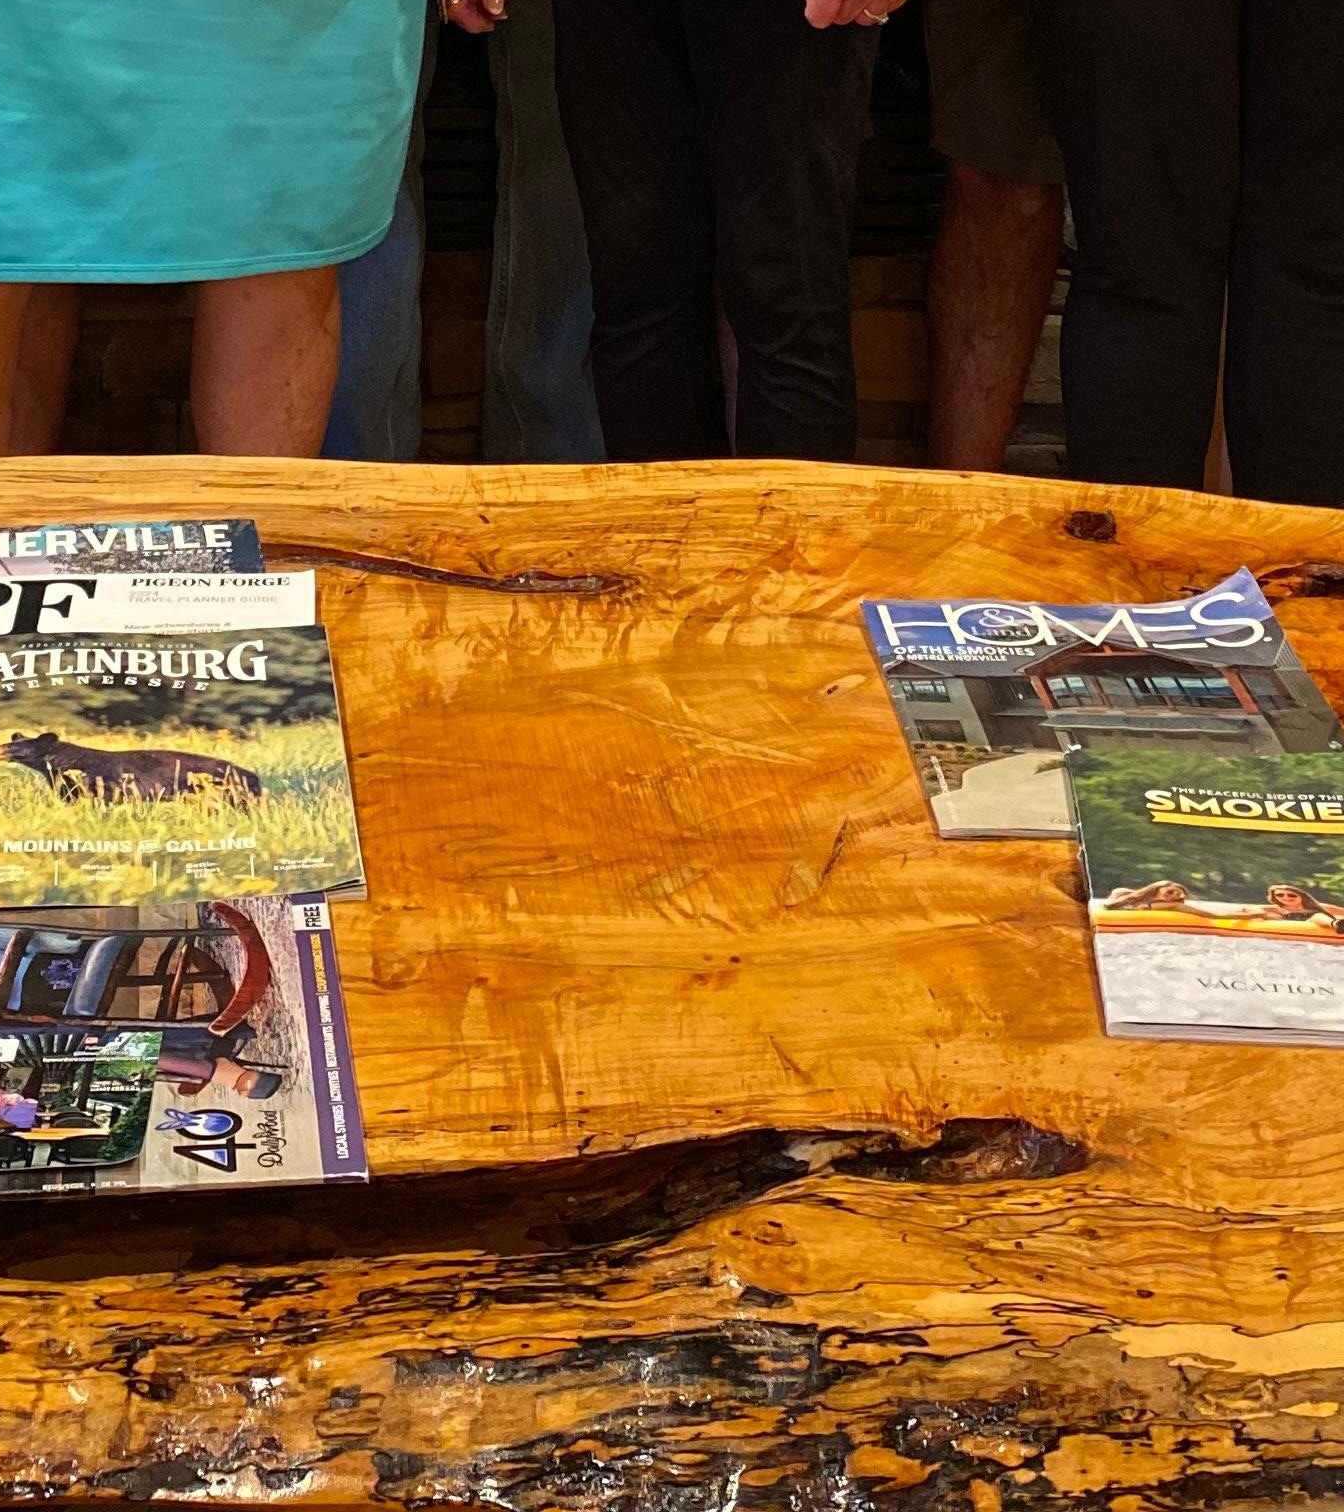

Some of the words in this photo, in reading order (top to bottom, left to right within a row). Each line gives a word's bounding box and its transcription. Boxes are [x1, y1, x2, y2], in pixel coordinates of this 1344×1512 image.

[131, 577, 211, 588] PIGEON
[219, 576, 291, 588] FORGE
[177, 595, 236, 604] PLANNER
[979, 608, 1018, 627] &
[971, 626, 1032, 637] Land
[893, 646, 916, 655] OF
[919, 646, 953, 655] THE
[956, 646, 1036, 657] SMOKIES
[947, 654, 1008, 662] KNOXVILLE
[1, 674, 210, 693] TENNESSEE
[1171, 786, 1195, 795] THE
[1198, 788, 1263, 799] PEACEFUL
[1266, 792, 1294, 801] SIDE
[1297, 793, 1316, 802] OF
[1318, 794, 1344, 802] THE
[3, 839, 133, 854] MOUNTAINS
[165, 837, 257, 853] CALLING
[304, 905, 322, 928] FREE
[1196, 976, 1336, 997] VACATION
[172, 1108, 257, 1174] 40
[335, 1133, 350, 1159] LOCAL
